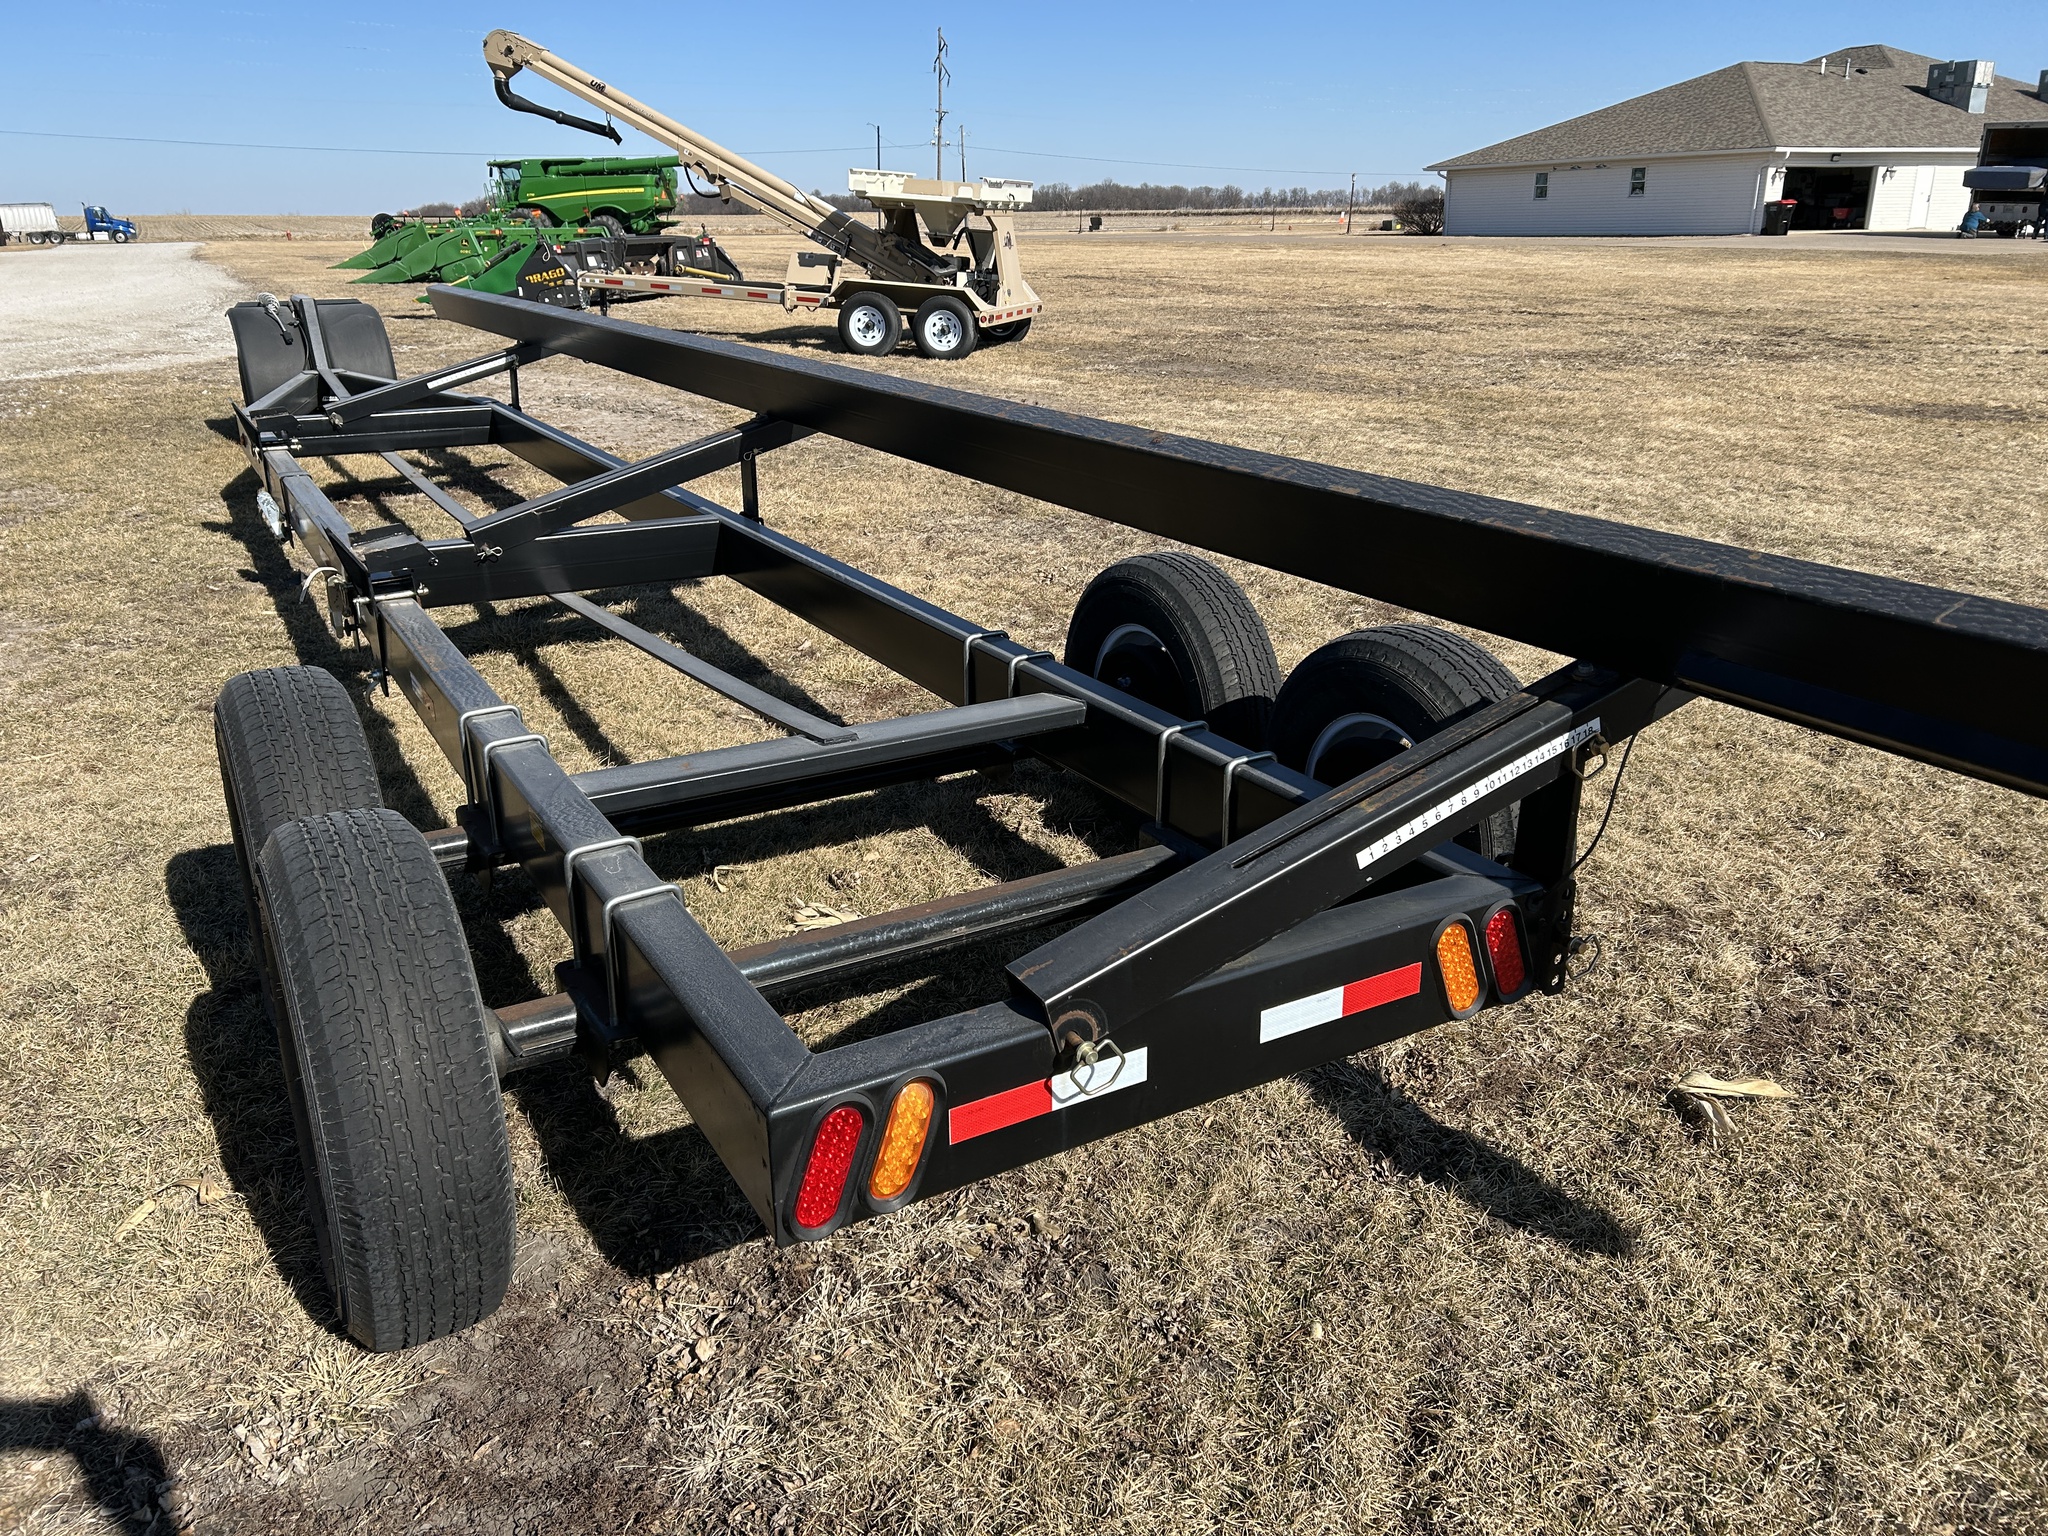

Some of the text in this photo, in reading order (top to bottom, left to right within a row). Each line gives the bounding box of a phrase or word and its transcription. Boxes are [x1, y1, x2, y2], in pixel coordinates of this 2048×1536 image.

[1369, 851, 1375, 860] 1
[1381, 843, 1389, 853] 2
[1395, 835, 1402, 845] 3
[1408, 827, 1415, 836] 4
[1422, 819, 1429, 829] 5
[1435, 811, 1442, 821] 6
[1447, 804, 1454, 813] 7
[1460, 796, 1467, 806] 8
[1473, 789, 1480, 798] 9
[1484, 780, 1496, 792] 10
[1497, 773, 1507, 784] 11
[1510, 765, 1520, 777] 12
[1522, 758, 1533, 770] 13
[1535, 752, 1545, 764] 14
[1547, 746, 1558, 757] 15
[1559, 739, 1570, 750] 16
[1571, 732, 1582, 744] 17
[1583, 726, 1594, 737] 18
